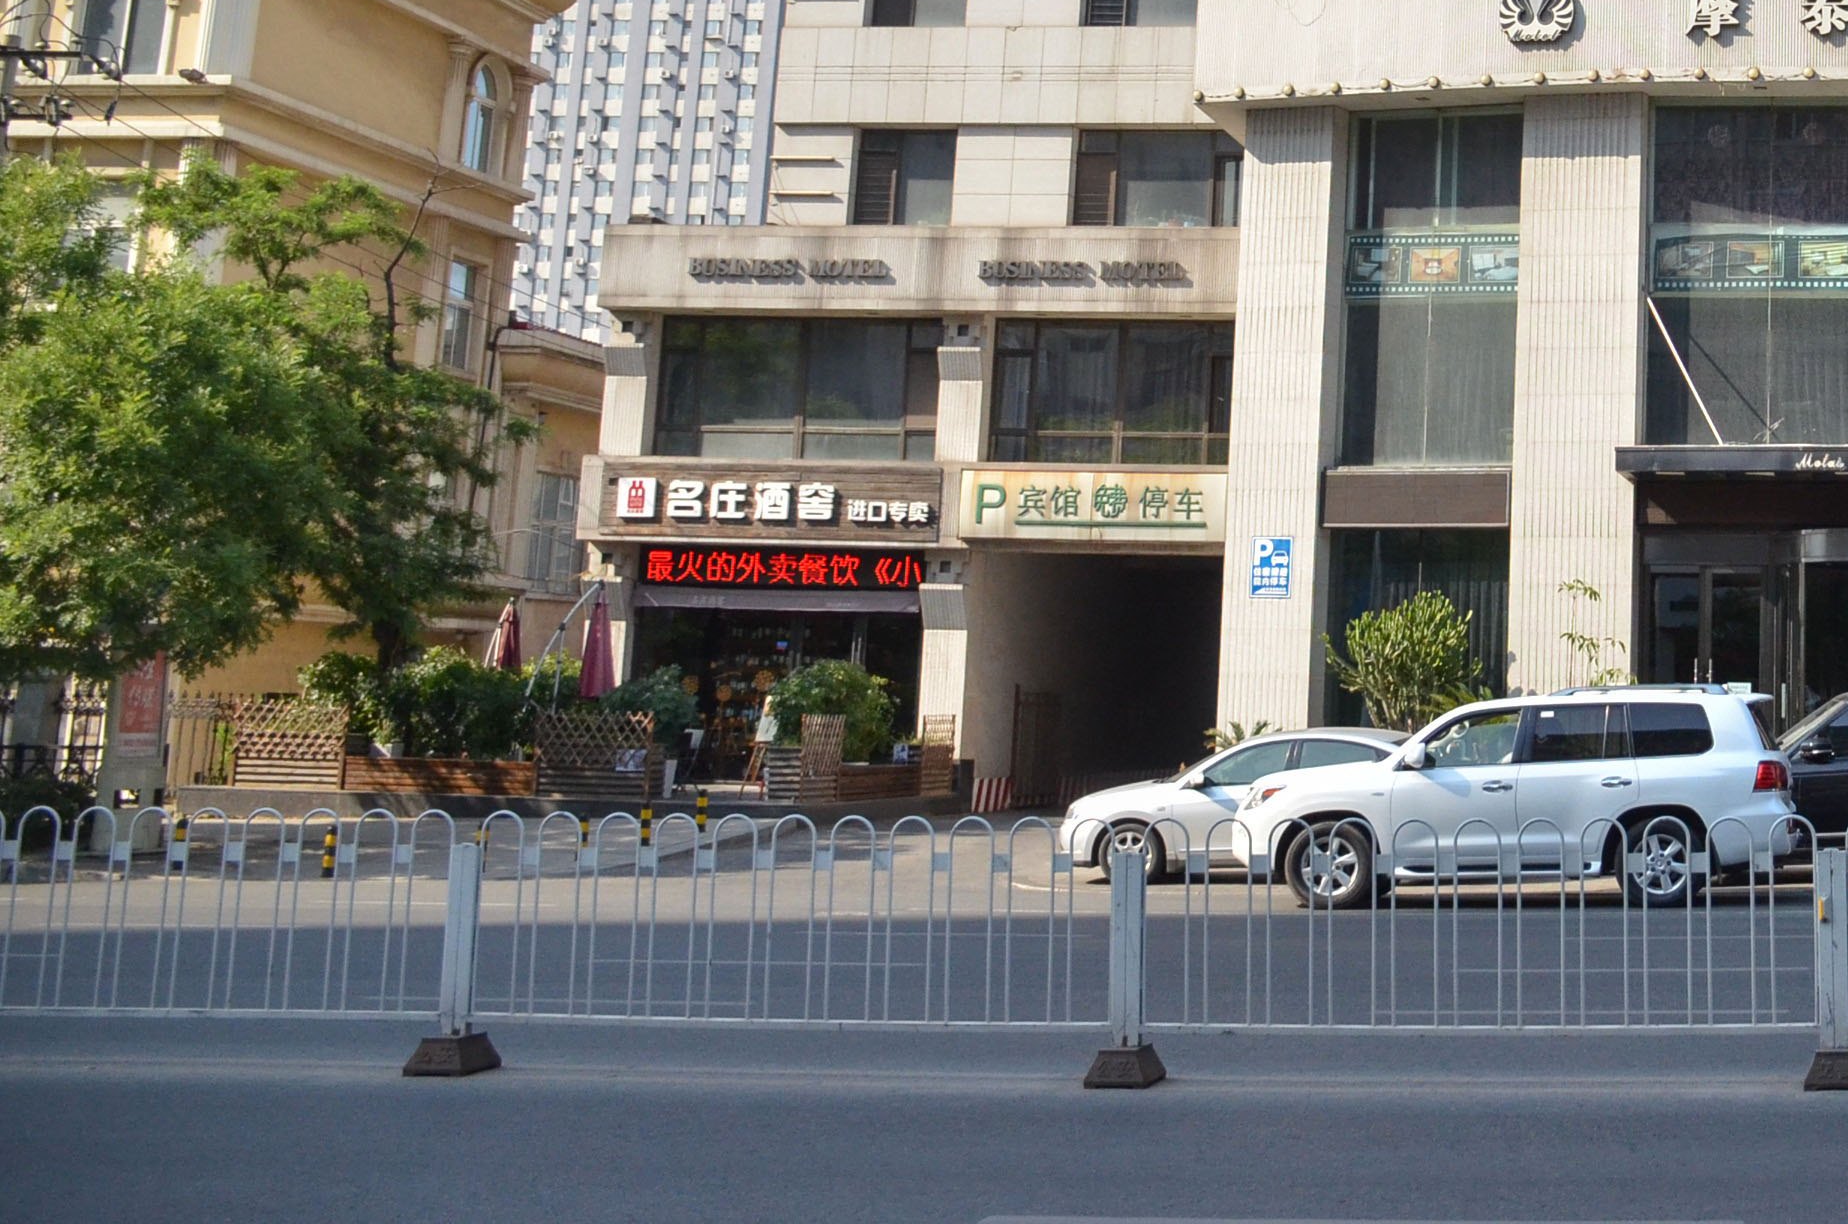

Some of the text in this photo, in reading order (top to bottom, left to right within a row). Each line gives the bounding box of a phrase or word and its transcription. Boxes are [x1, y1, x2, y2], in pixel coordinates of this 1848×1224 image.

[687, 257, 890, 278] BUSINESS MOTEL
[978, 259, 1186, 281] BUSINESS MOTEL
[667, 480, 930, 523] 名庄酒窖 进口专卖
[975, 483, 1007, 524] P
[1253, 539, 1274, 566] P
